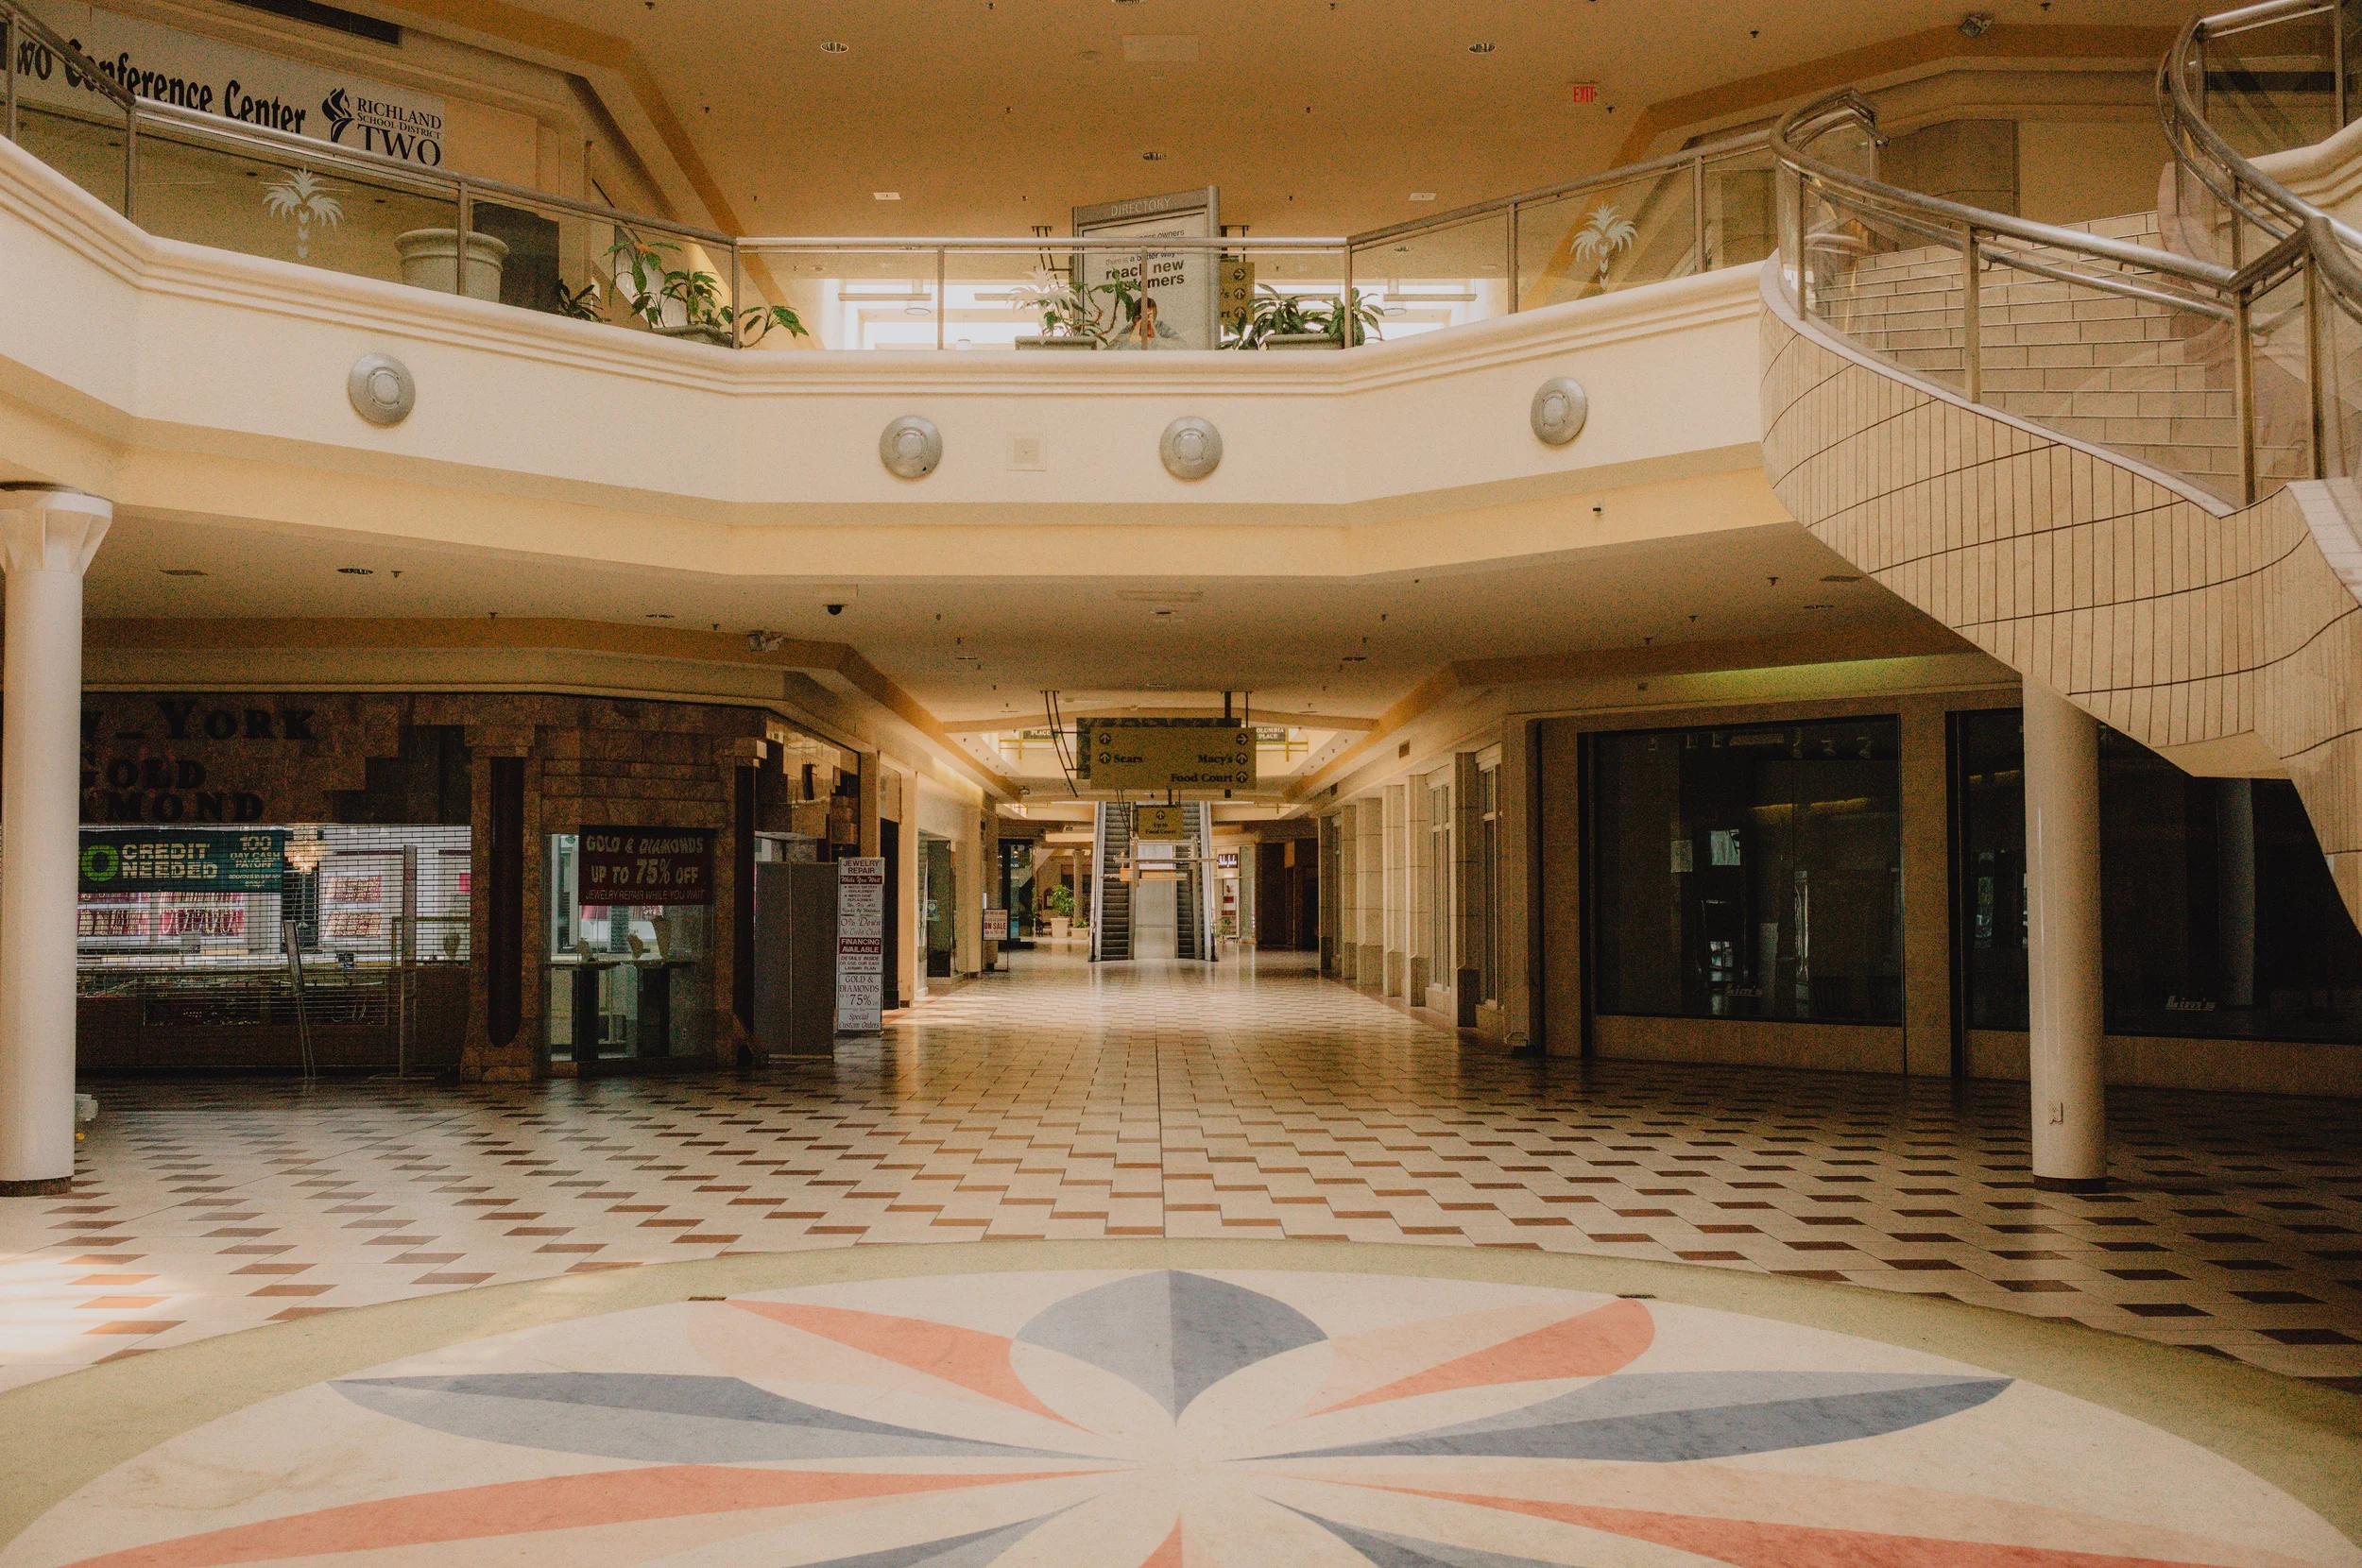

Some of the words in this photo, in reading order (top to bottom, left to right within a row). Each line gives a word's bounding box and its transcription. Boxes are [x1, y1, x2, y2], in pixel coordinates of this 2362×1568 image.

[1573, 86, 1594, 102] EXIT
[225, 80, 306, 134] Center
[357, 97, 441, 129] RICHLAND
[357, 124, 441, 166] TWO
[1111, 196, 1172, 216] DIRECTORY
[1137, 251, 1159, 262] btter
[1153, 260, 1185, 274] new
[1106, 274, 1185, 294] smers
[1114, 754, 1143, 764] Sears
[1198, 754, 1232, 765] Macy's
[1171, 773, 1198, 783] Food
[1201, 773, 1232, 783] Court
[81, 791, 264, 823] MOND
[121, 843, 211, 860] CREDIT
[240, 836, 271, 851] 100
[586, 835, 621, 853] GOLD
[639, 837, 704, 855] DIAMONDS
[81, 844, 119, 882] O
[121, 861, 218, 879] NEEDED
[235, 860, 274, 868] PAYOFF
[590, 865, 607, 884] UP
[611, 865, 630, 884] TO
[636, 858, 672, 885] 75%
[675, 865, 699, 885] OFF
[585, 889, 618, 901] JEWELRY
[619, 889, 644, 901] REPAIR
[859, 917, 881, 926] Down
[850, 995, 872, 1005] 75%
